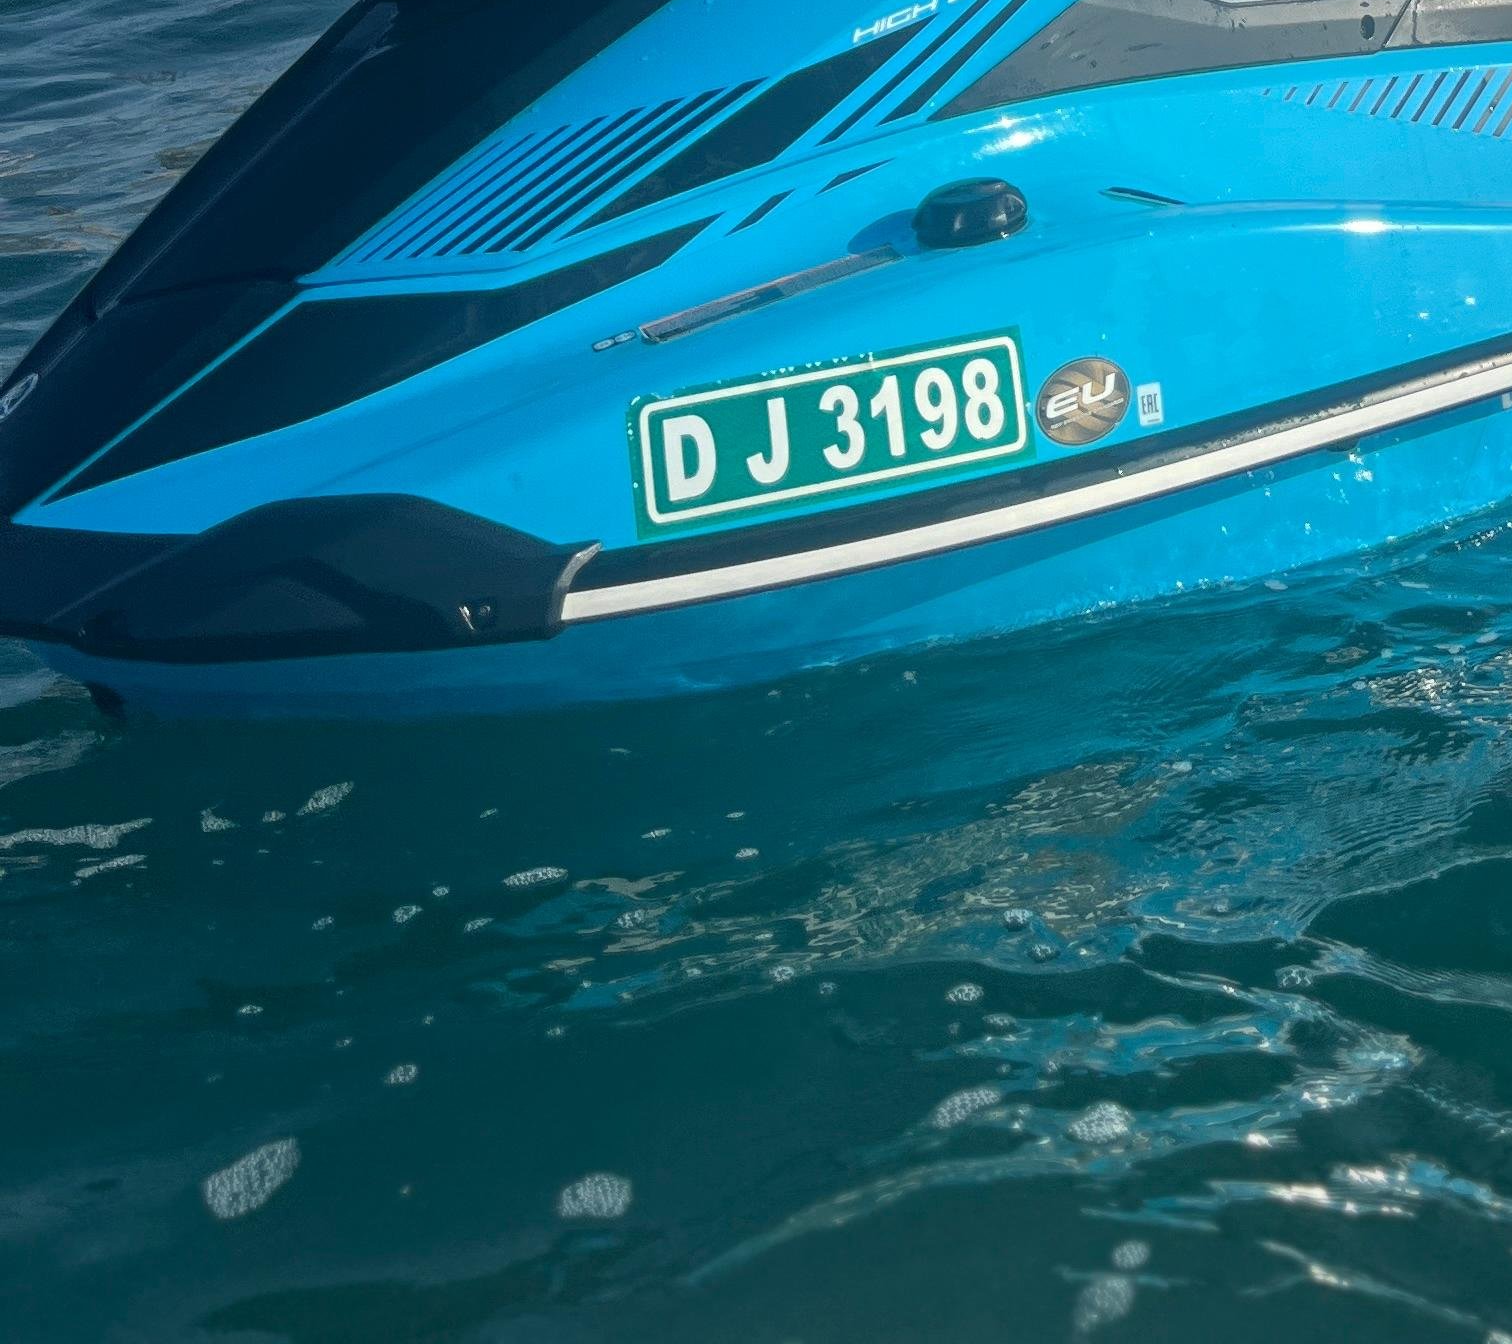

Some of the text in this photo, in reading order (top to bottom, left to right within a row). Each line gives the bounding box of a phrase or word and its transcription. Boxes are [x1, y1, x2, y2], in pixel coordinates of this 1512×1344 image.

[662, 358, 1004, 502] D J 3198
